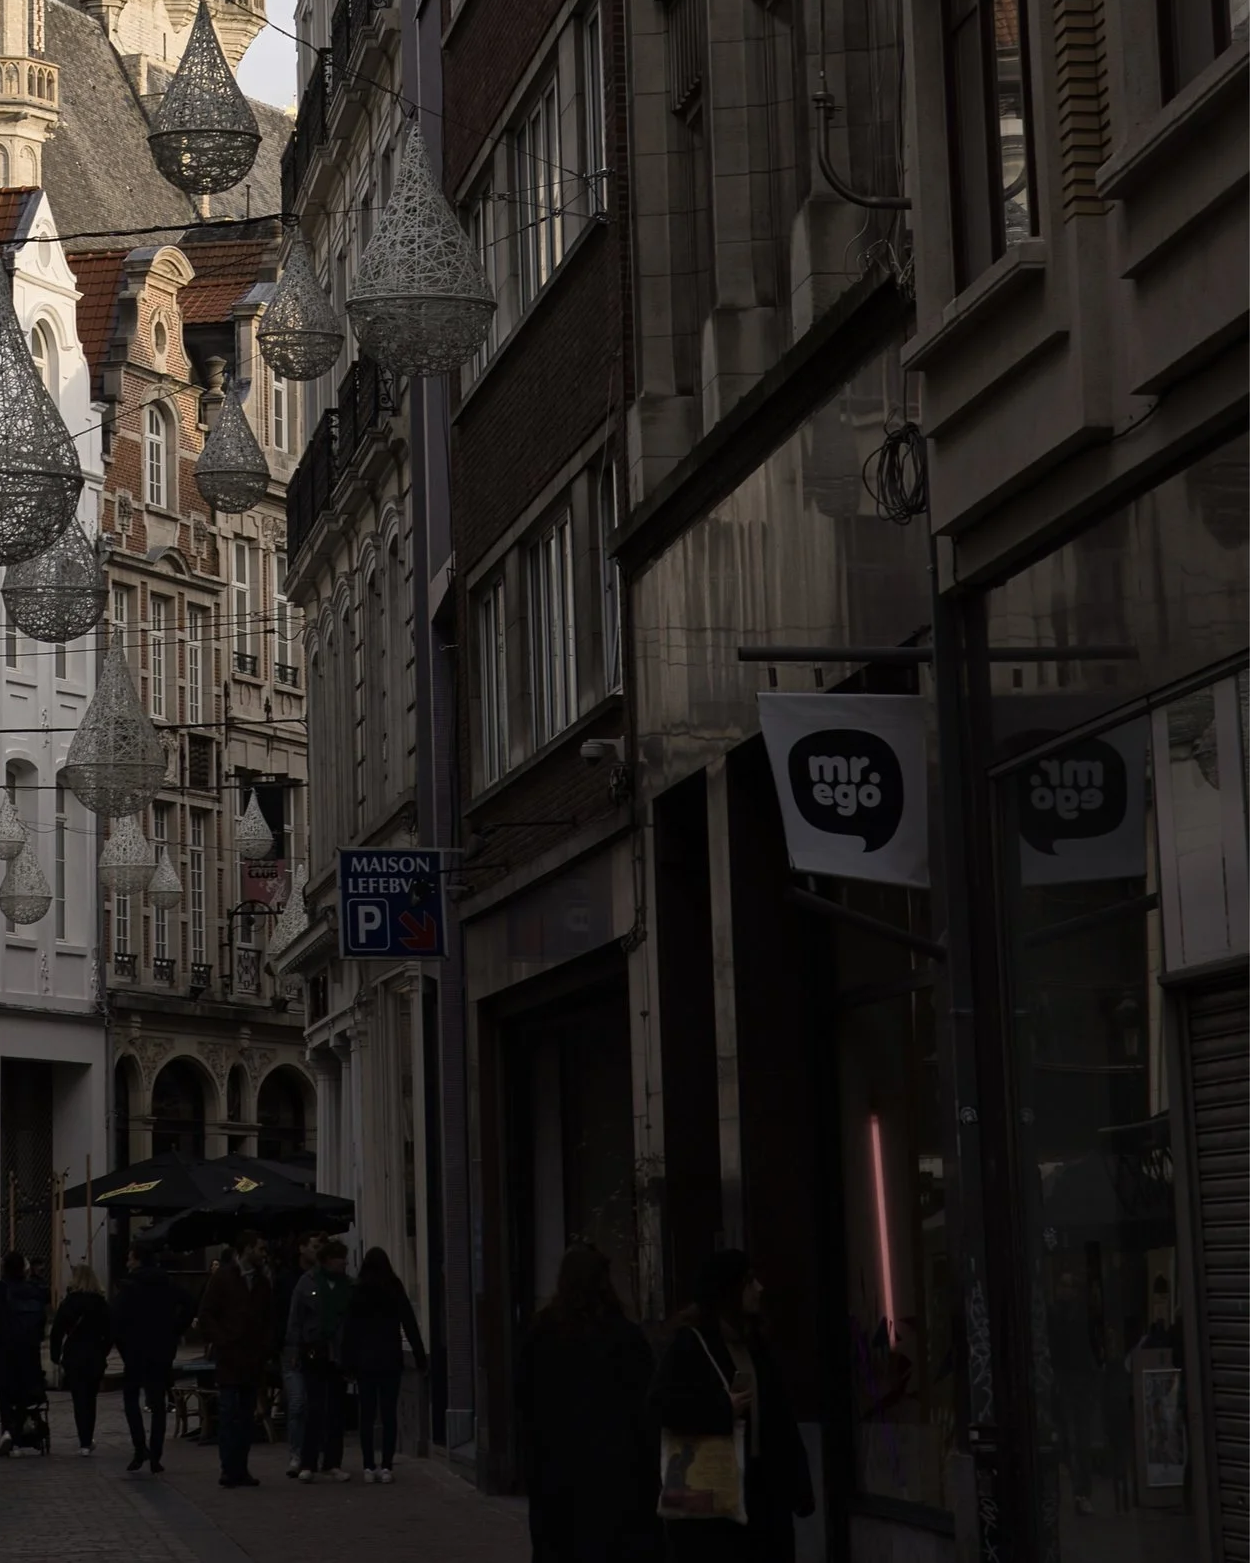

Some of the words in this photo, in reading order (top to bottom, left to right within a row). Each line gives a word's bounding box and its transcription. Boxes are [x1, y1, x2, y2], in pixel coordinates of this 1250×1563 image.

[808, 754, 881, 783] mr.
[812, 782, 881, 817] ego
[350, 856, 430, 874] MAISON
[348, 877, 437, 894] LEFEBV
[357, 905, 382, 944] P
